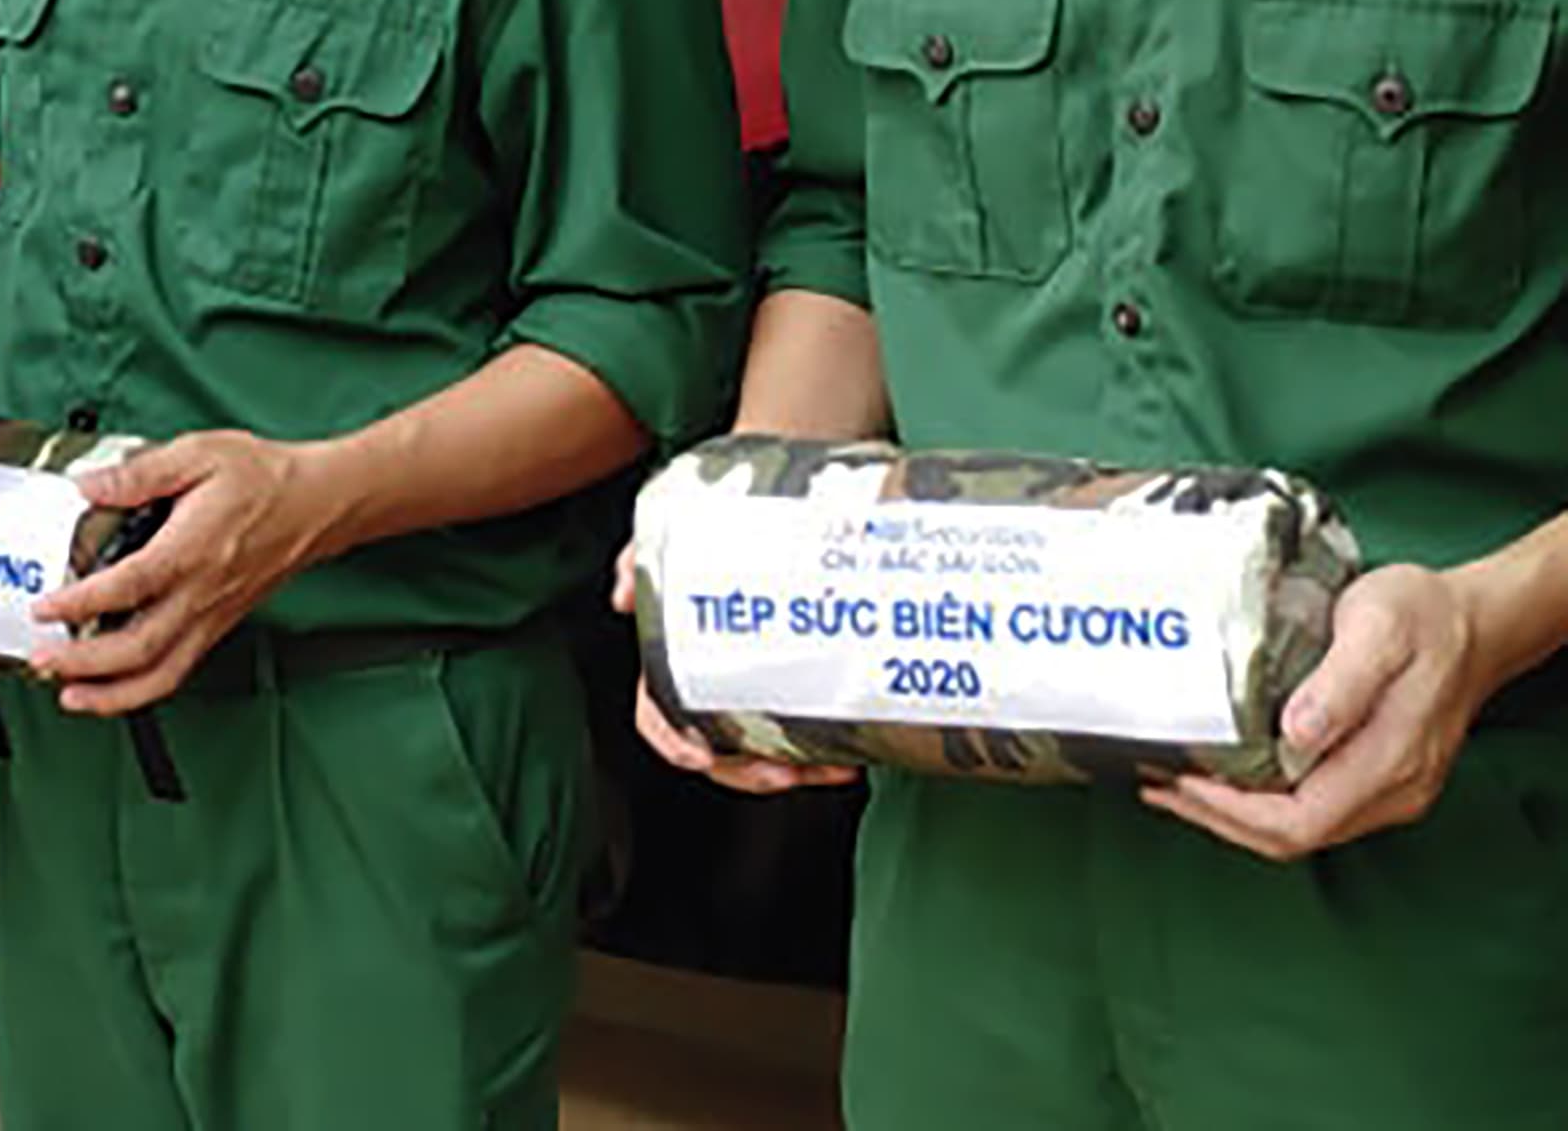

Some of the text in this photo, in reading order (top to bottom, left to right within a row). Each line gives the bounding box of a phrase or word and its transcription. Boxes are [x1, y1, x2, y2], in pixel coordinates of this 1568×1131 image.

[689, 586, 1191, 649] TIẾP SỨC BIÊN CƯƠNG
[882, 657, 982, 698] 2020
